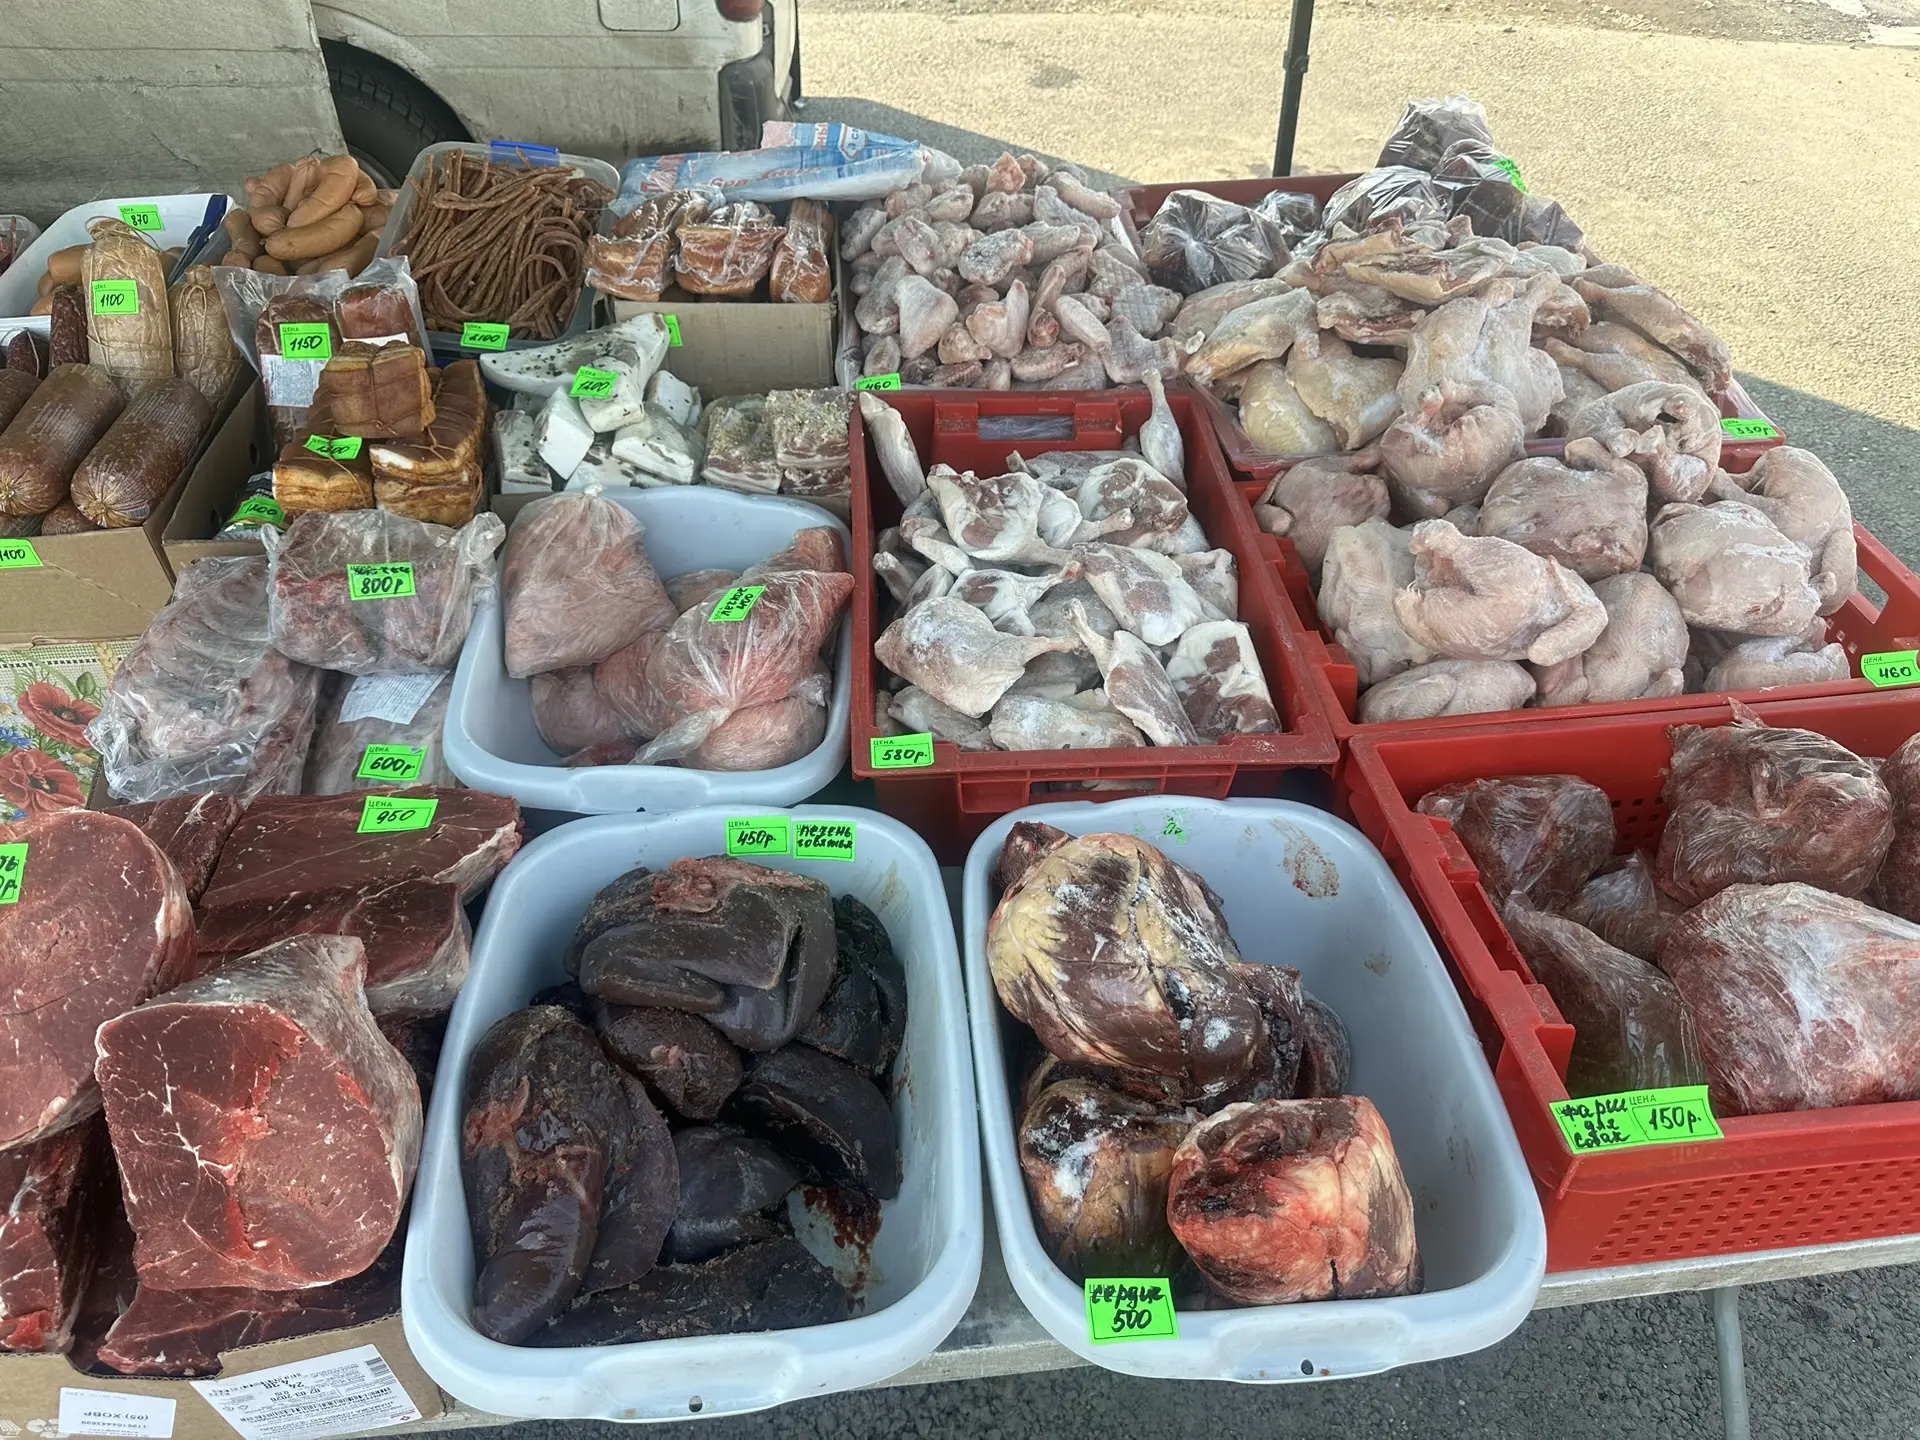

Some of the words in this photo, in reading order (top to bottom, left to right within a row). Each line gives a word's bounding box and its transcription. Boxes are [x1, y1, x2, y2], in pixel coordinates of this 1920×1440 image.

[130, 214, 149, 226] 870
[100, 293, 125, 307] 1100
[290, 335, 323, 351] 1150
[865, 380, 892, 390] 460
[1863, 656, 1883, 664] ЦЕНА
[1879, 666, 1912, 679] 460
[881, 748, 928, 764] 580р.
[368, 800, 393, 808] ЦЕНА
[728, 820, 750, 828] ЦЕНА
[1629, 1095, 1657, 1105] ЦЕНА
[1111, 1309, 1152, 1332] 500
